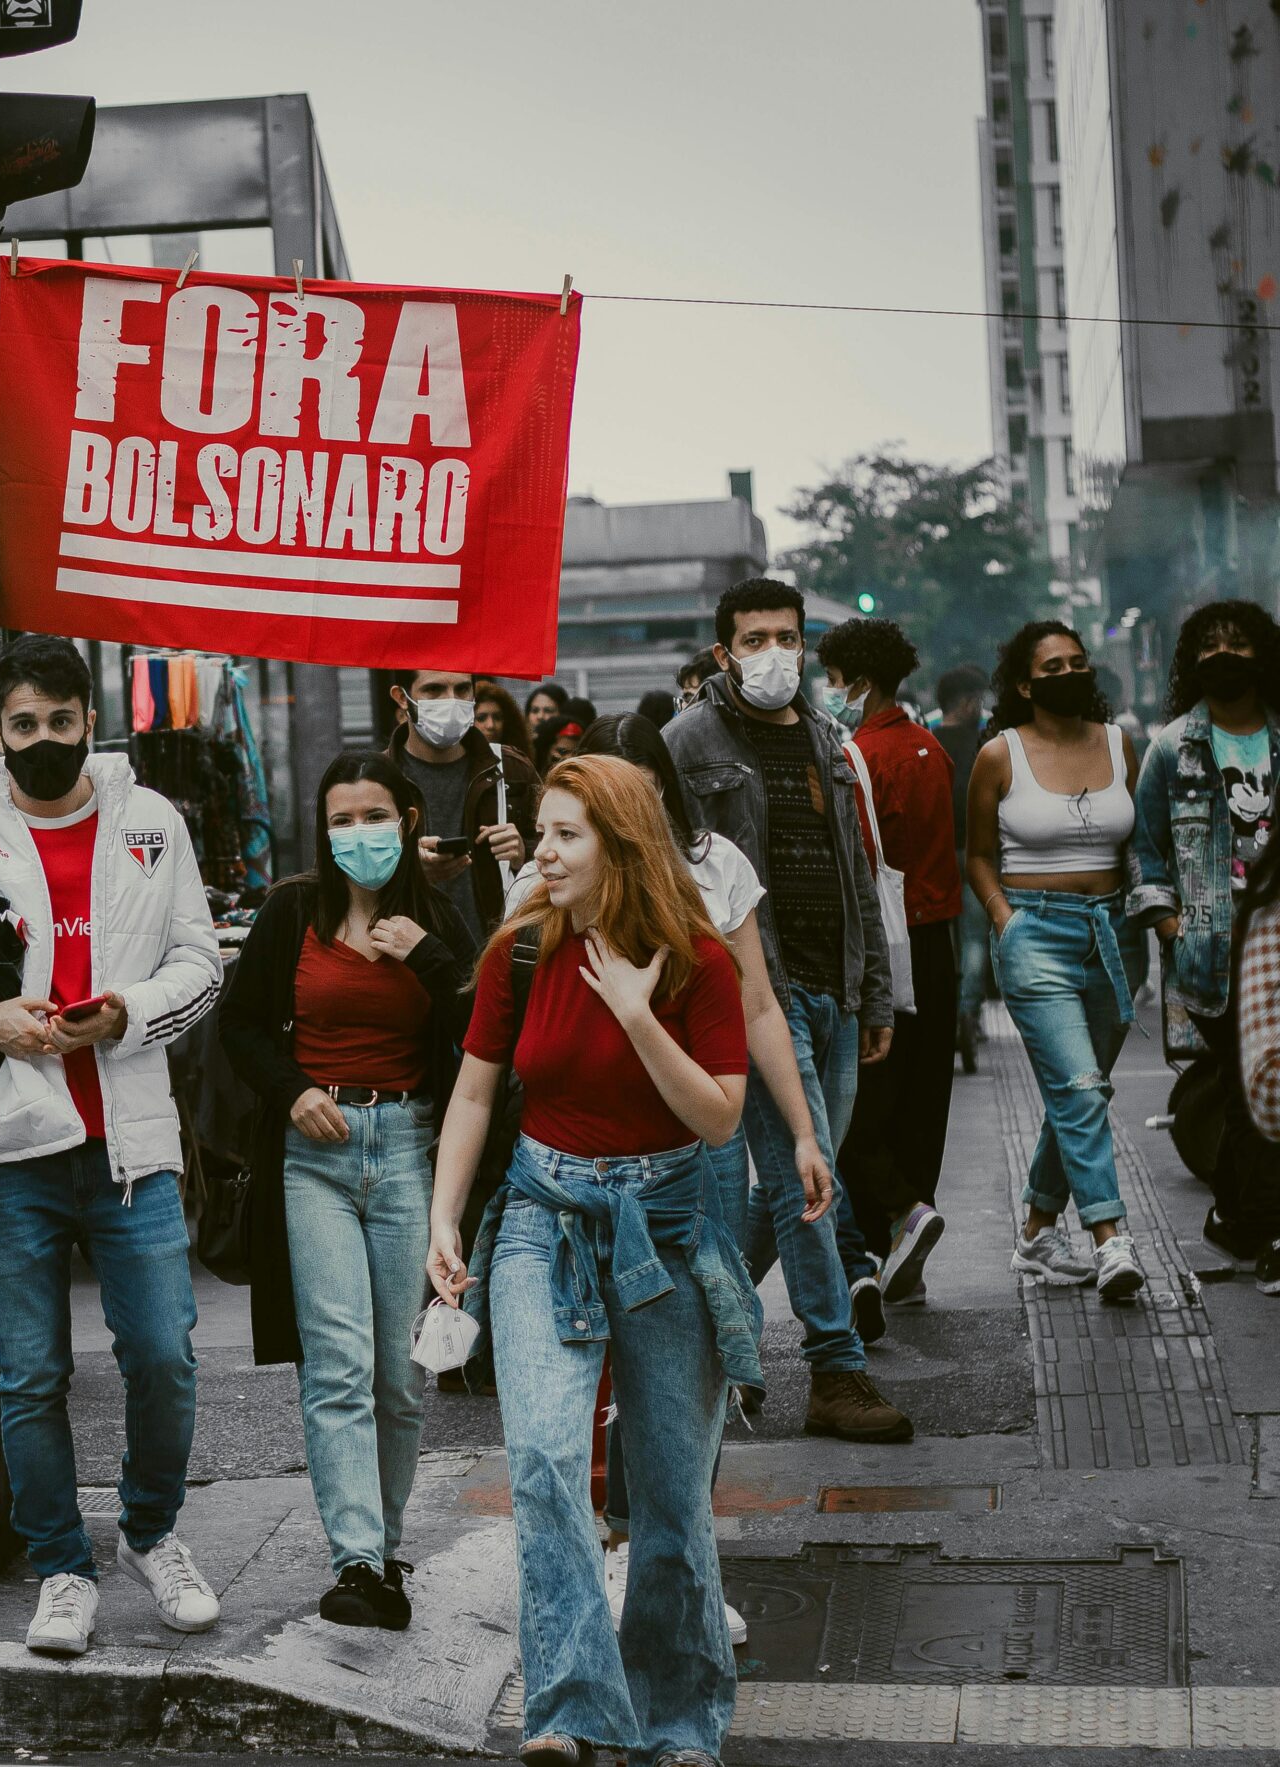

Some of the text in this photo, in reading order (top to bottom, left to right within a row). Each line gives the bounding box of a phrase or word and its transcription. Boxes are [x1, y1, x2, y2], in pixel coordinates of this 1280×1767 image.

[74, 277, 471, 447] FORA
[62, 430, 470, 556] BOLSONARO
[126, 833, 163, 845] SPFC
